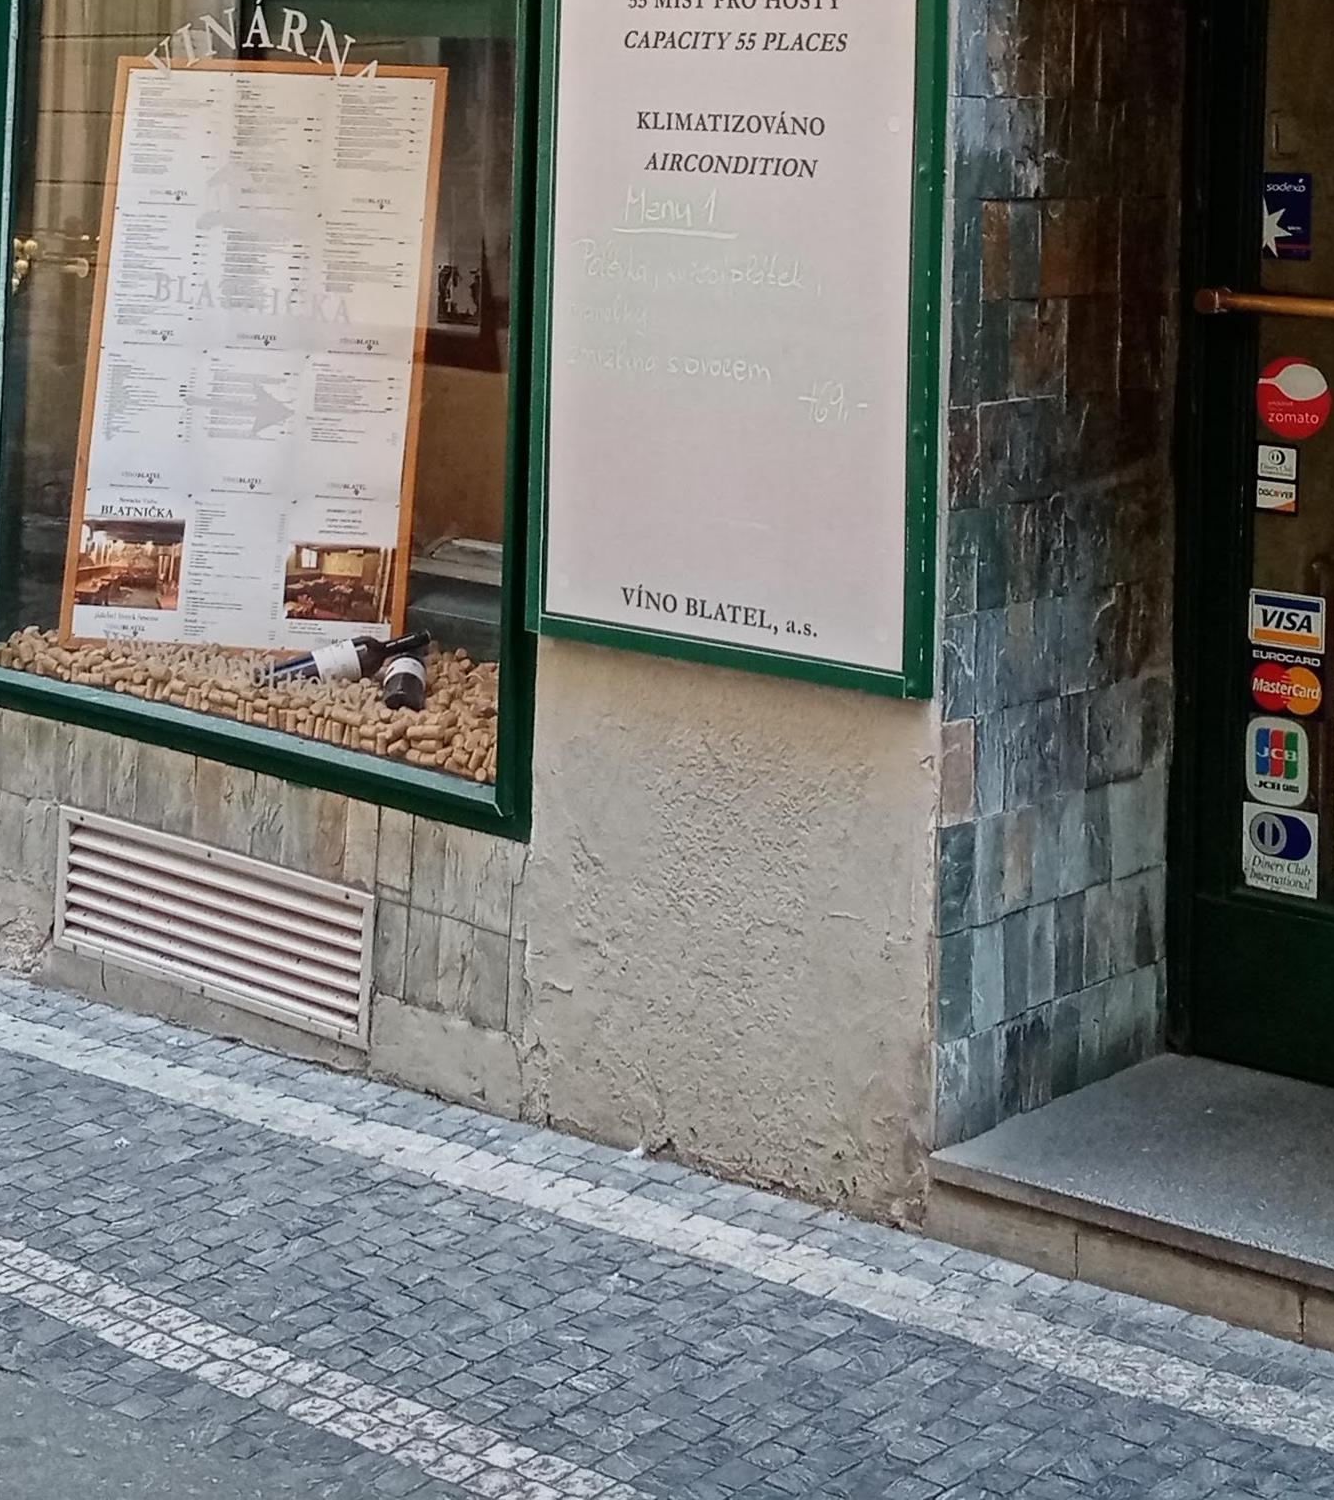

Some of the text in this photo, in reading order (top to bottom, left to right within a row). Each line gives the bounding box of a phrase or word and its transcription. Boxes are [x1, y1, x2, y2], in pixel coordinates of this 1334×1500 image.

[624, 30, 848, 53] CAPACITY 55 PLACES
[637, 111, 825, 137] KLIMATIZOVÁNO
[645, 153, 817, 179] AIRCONDITION
[1268, 412, 1320, 425] zomato
[100, 504, 174, 519] BLATNIČKA
[621, 585, 817, 638] VÍNO BLATEL, a.s.
[1262, 608, 1313, 634] VISA
[1252, 649, 1321, 667] EUROCARD
[1252, 677, 1322, 702] MasterCard
[1257, 746, 1297, 762] JCB
[1252, 855, 1311, 877] Diners Club
